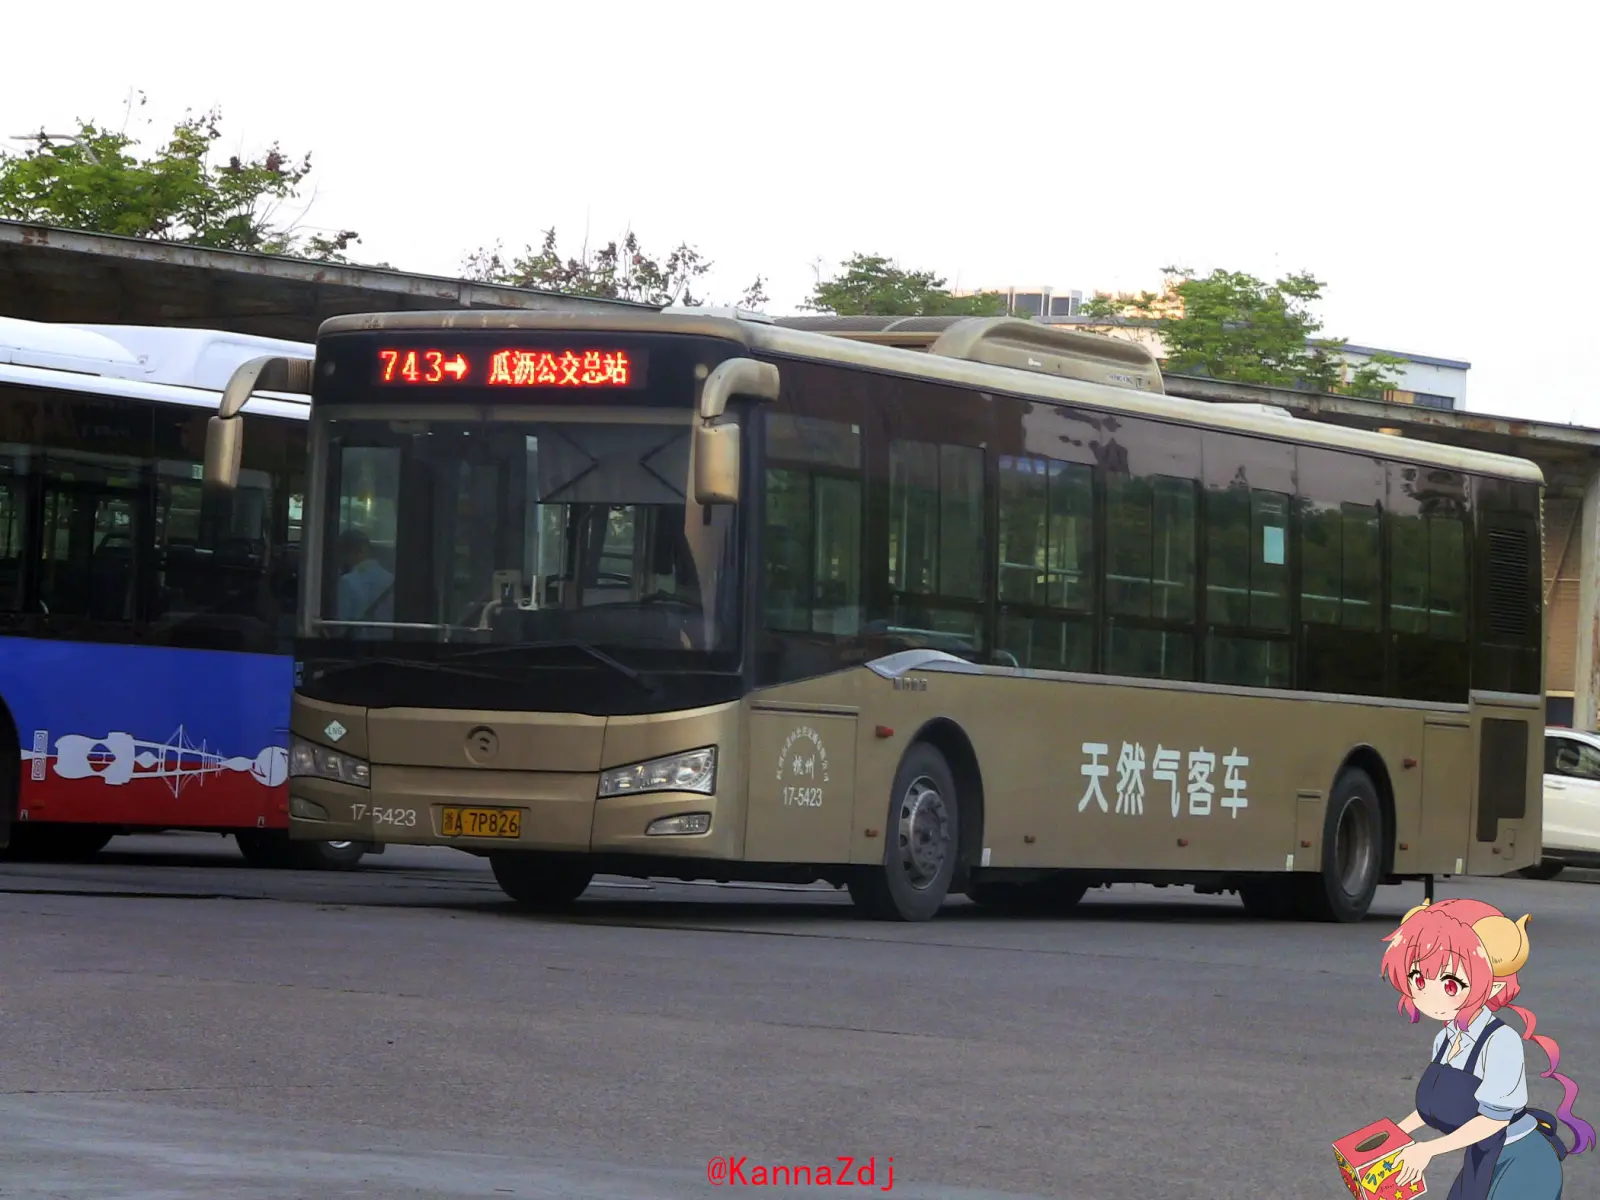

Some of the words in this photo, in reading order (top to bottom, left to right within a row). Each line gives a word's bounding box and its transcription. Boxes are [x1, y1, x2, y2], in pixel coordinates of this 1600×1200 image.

[379, 350, 443, 382] 743
[488, 350, 628, 385] 瓜沥公交总站
[328, 726, 343, 736] LNG
[1078, 740, 1249, 819] 天然气客车
[783, 786, 822, 807] 17-5423
[350, 804, 417, 827] 17-5423
